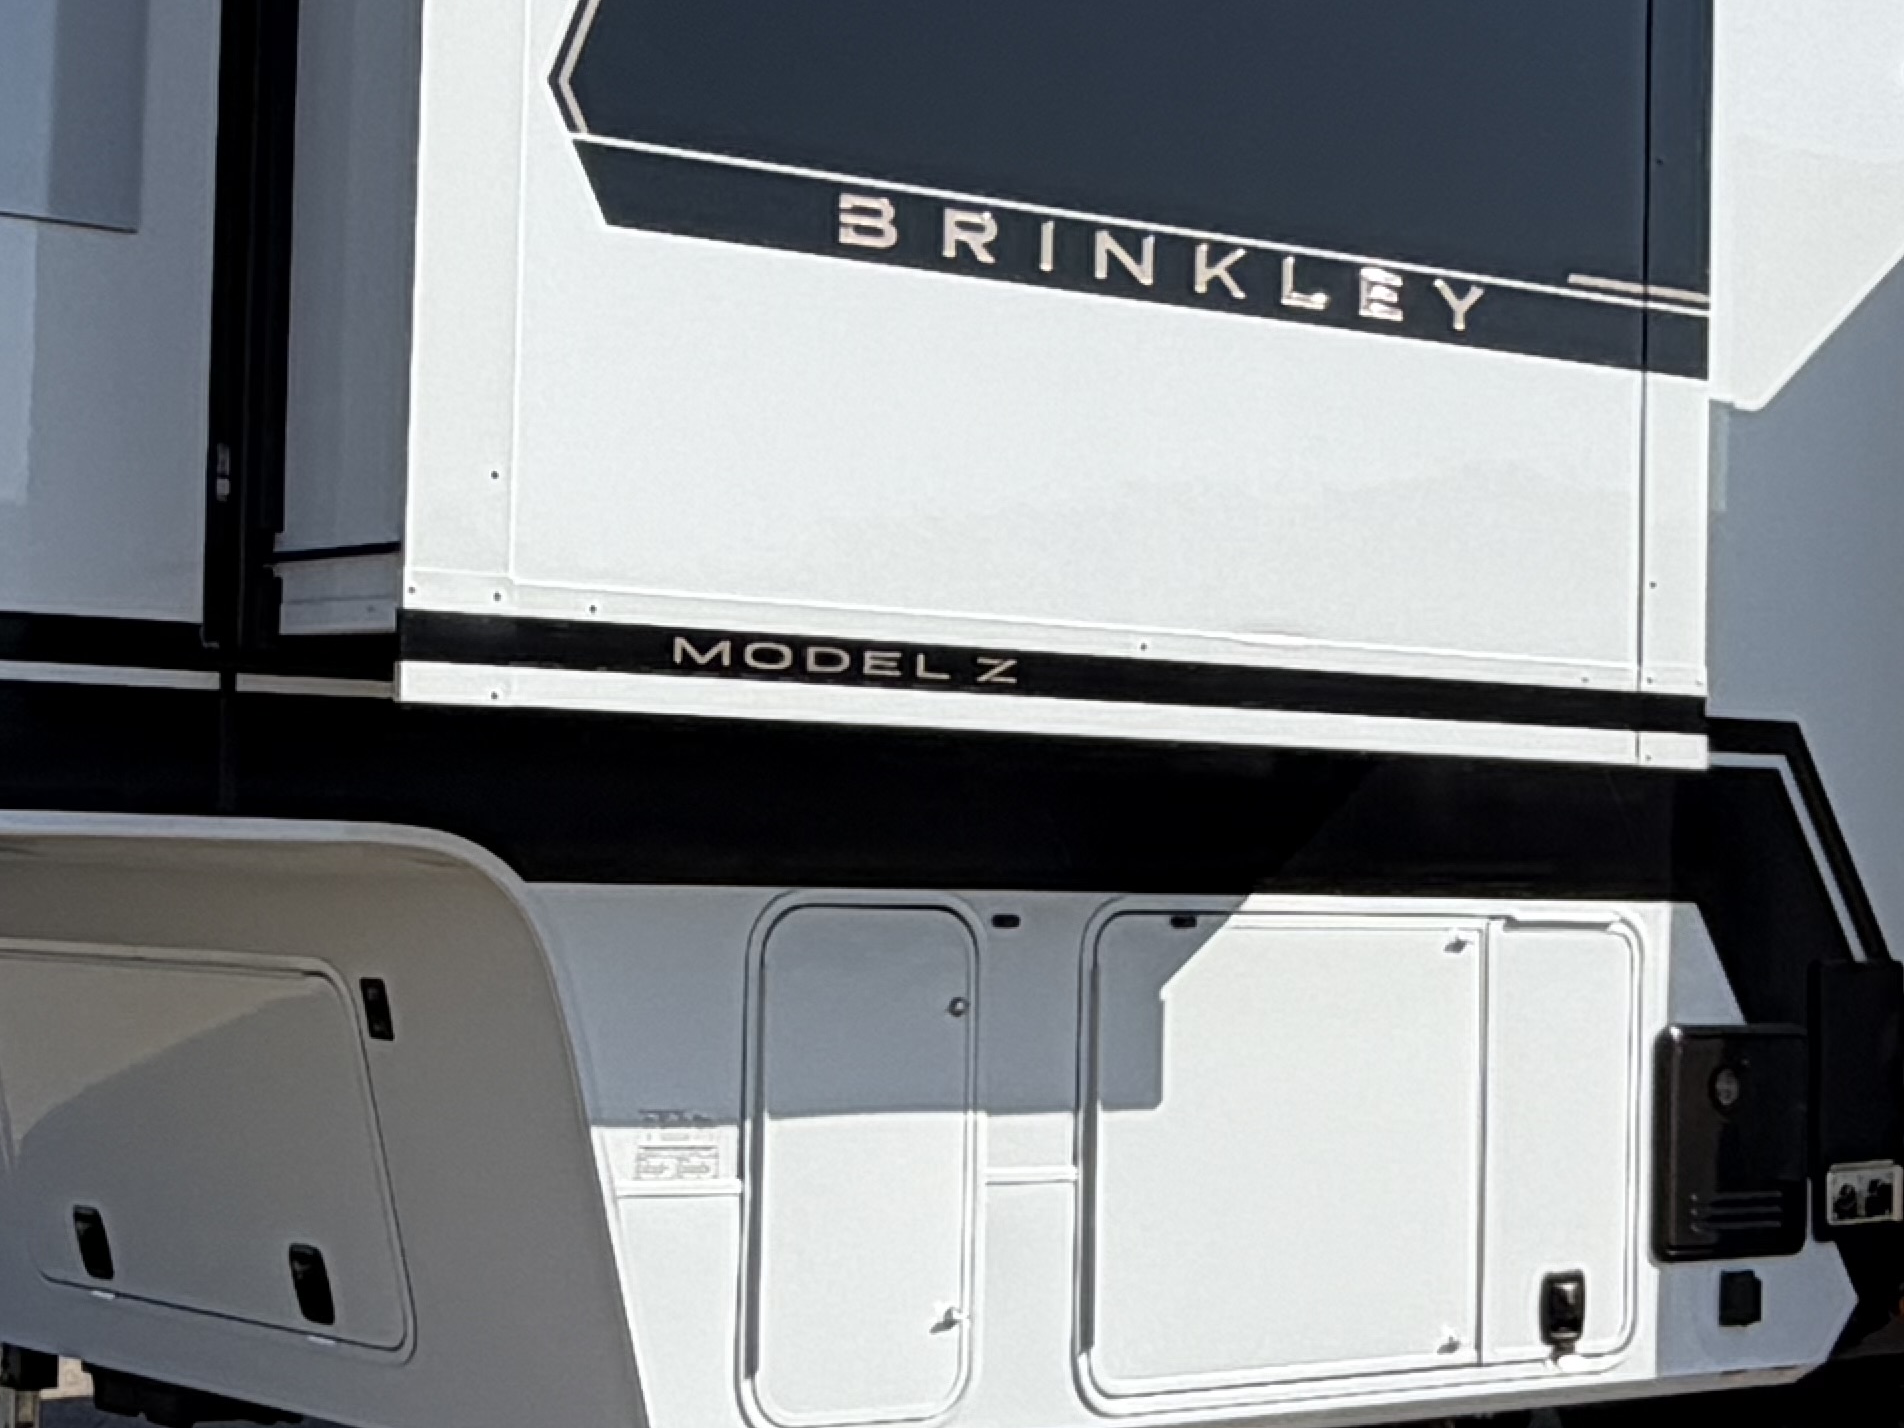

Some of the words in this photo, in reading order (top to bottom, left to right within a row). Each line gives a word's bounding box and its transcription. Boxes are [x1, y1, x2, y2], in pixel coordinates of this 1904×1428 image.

[837, 192, 1485, 332] BRINKLEY
[672, 635, 951, 681] MODEL
[976, 656, 1018, 685] Z
